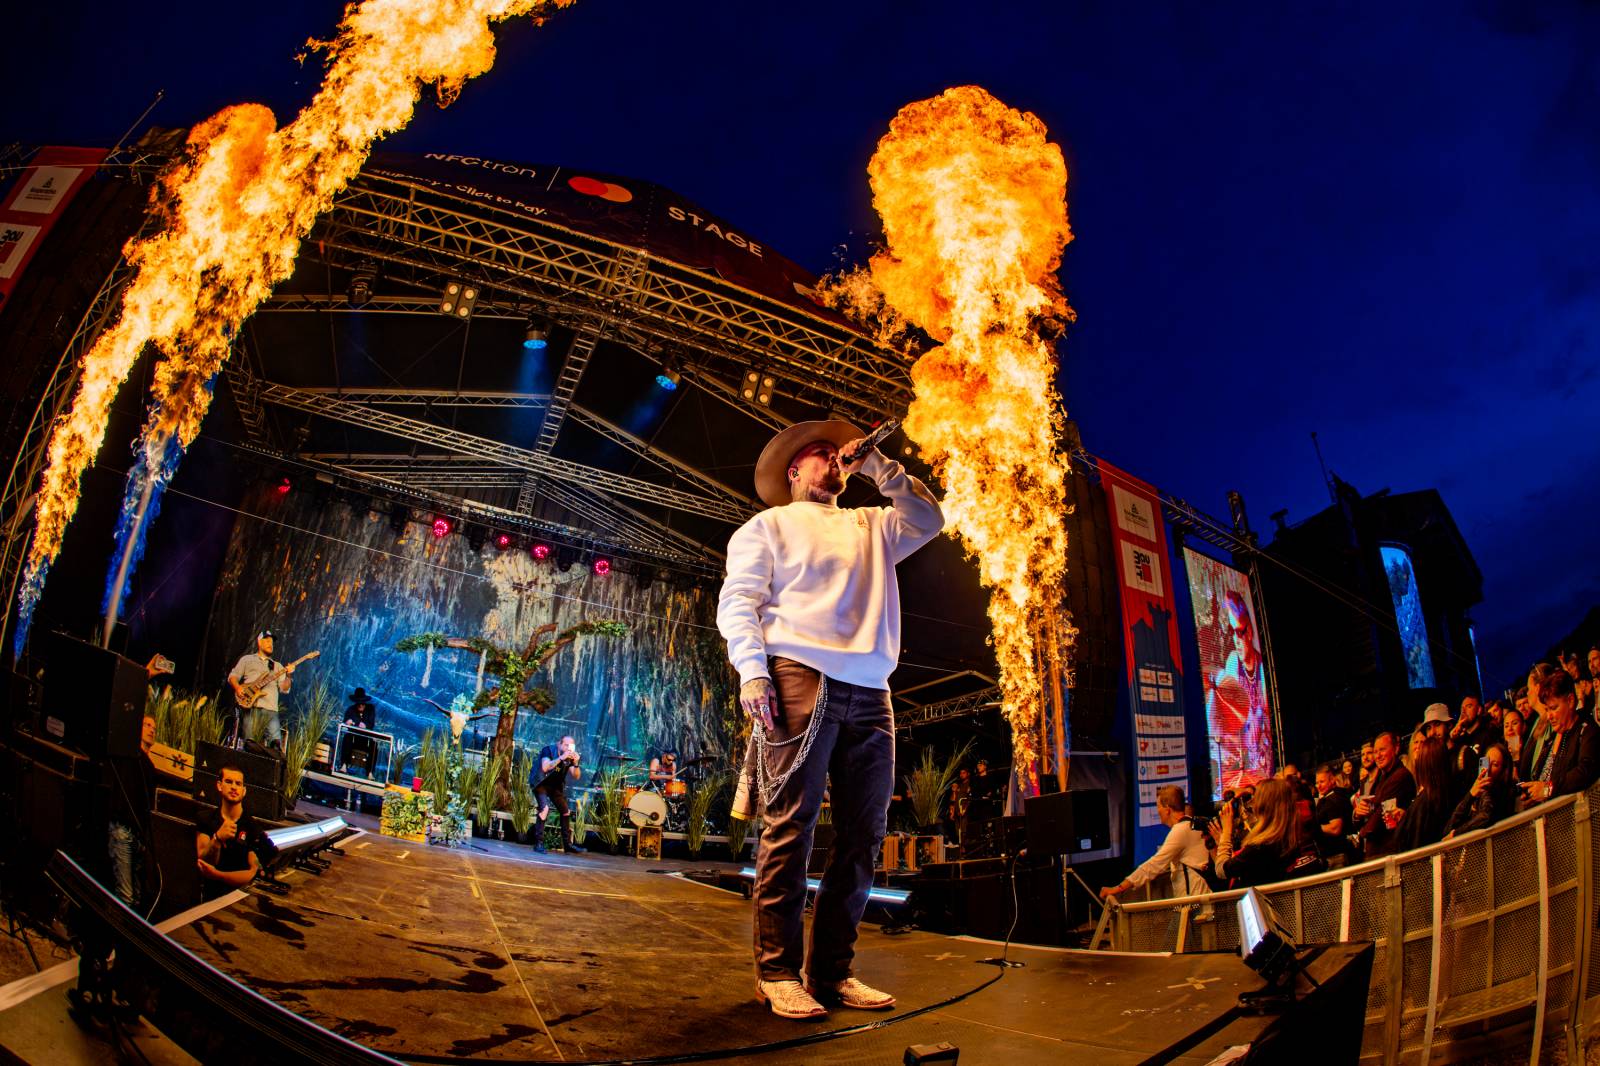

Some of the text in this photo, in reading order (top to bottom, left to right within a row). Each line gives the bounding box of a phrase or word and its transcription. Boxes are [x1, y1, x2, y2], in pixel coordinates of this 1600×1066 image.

[423, 152, 537, 178] NFCtron
[456, 184, 494, 200] Click
[496, 195, 512, 204] to
[515, 201, 549, 216] Pay.
[668, 206, 763, 257] STAGE
